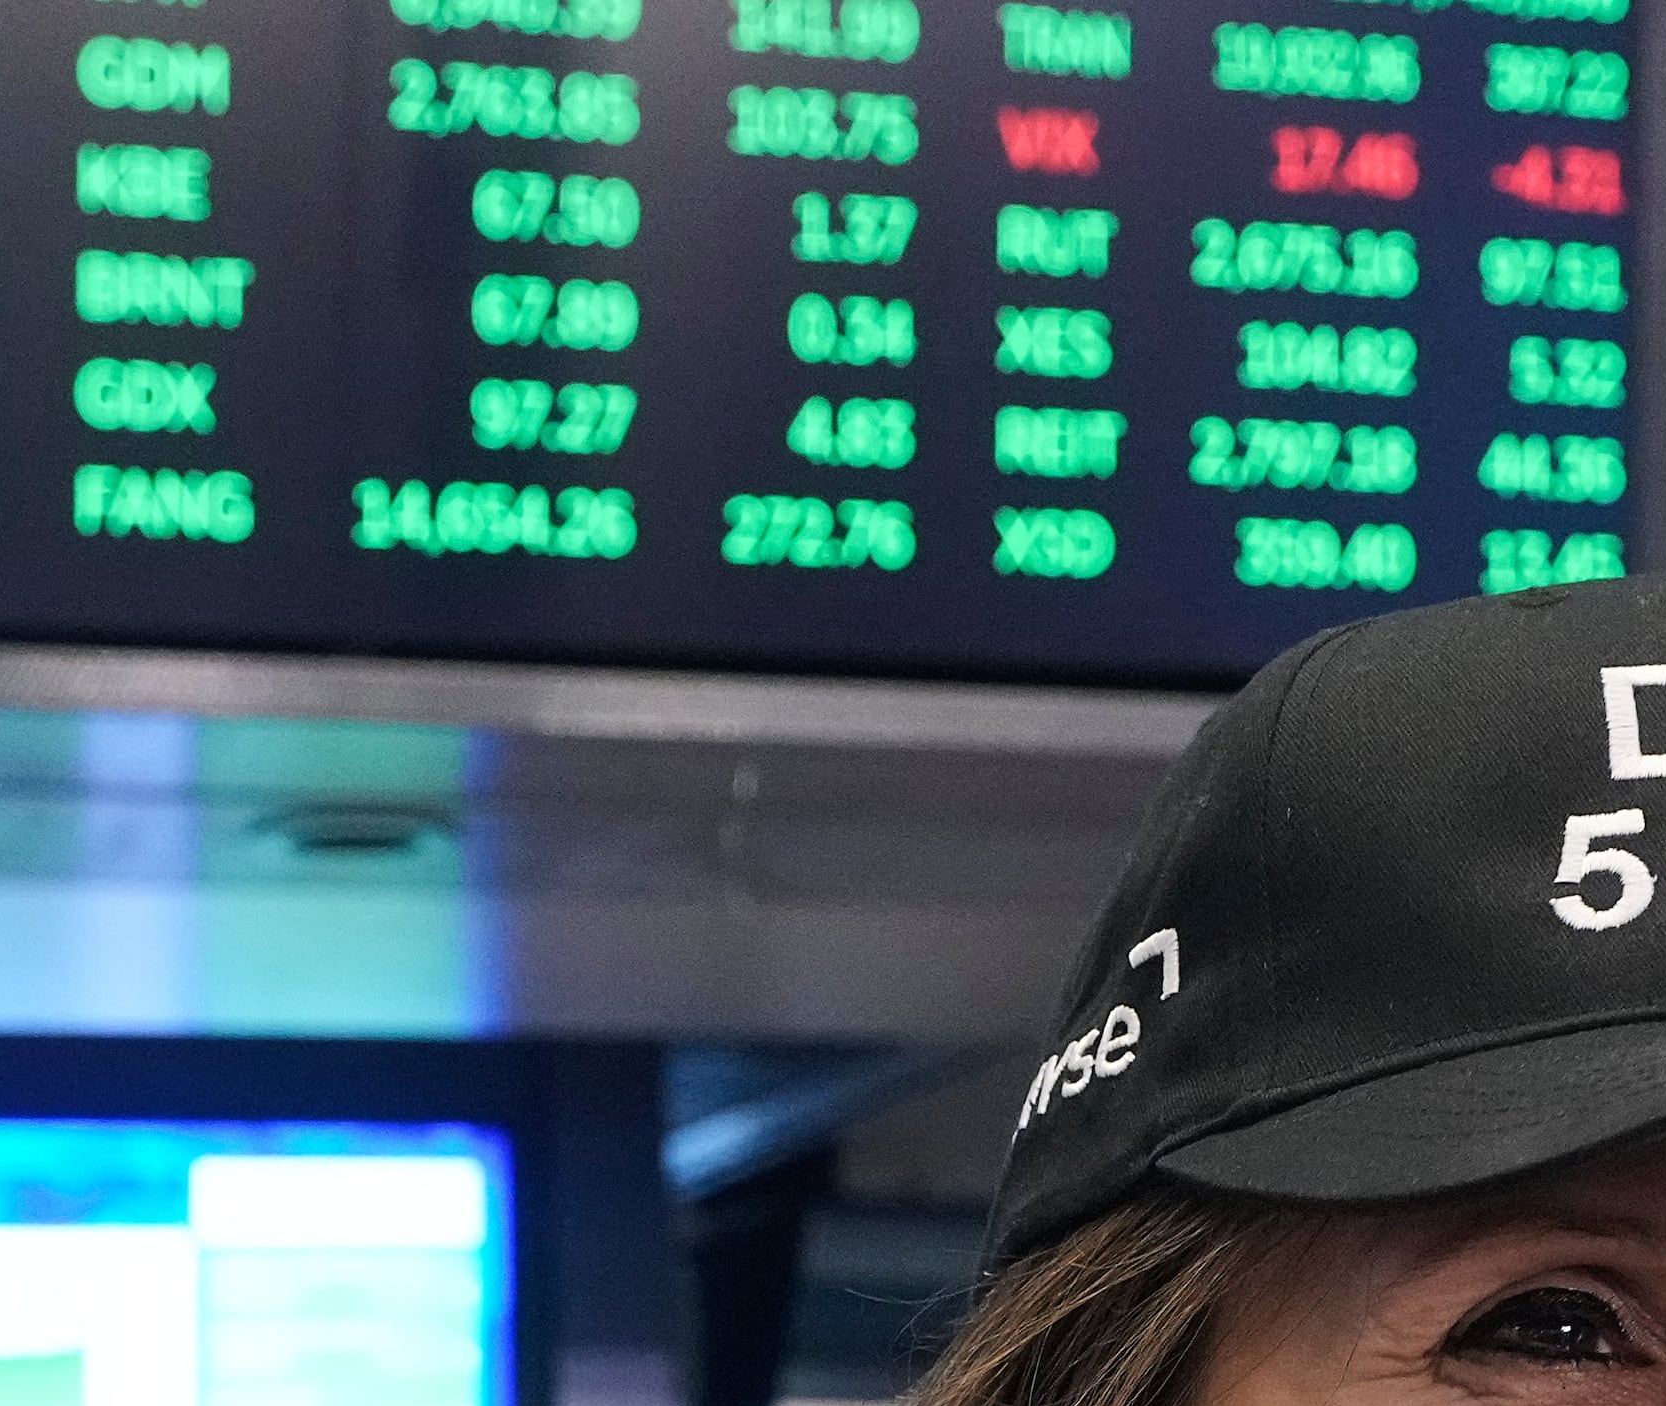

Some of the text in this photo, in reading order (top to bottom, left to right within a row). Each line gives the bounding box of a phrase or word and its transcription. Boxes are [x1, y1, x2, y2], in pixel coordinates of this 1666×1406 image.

[77, 36, 230, 112] GDM
[794, 193, 917, 263] 1.37
[76, 250, 253, 326] BRNT
[788, 294, 916, 365] 0.34
[74, 358, 215, 432] GDX
[471, 379, 637, 453] 97.27
[997, 308, 1112, 378] XES
[1510, 337, 1625, 407] 5.32
[995, 406, 1125, 477] REIT
[1479, 435, 1626, 503] 44.36
[74, 465, 254, 542] FANG
[723, 495, 915, 569] 272.76
[995, 509, 1115, 578] XSD
